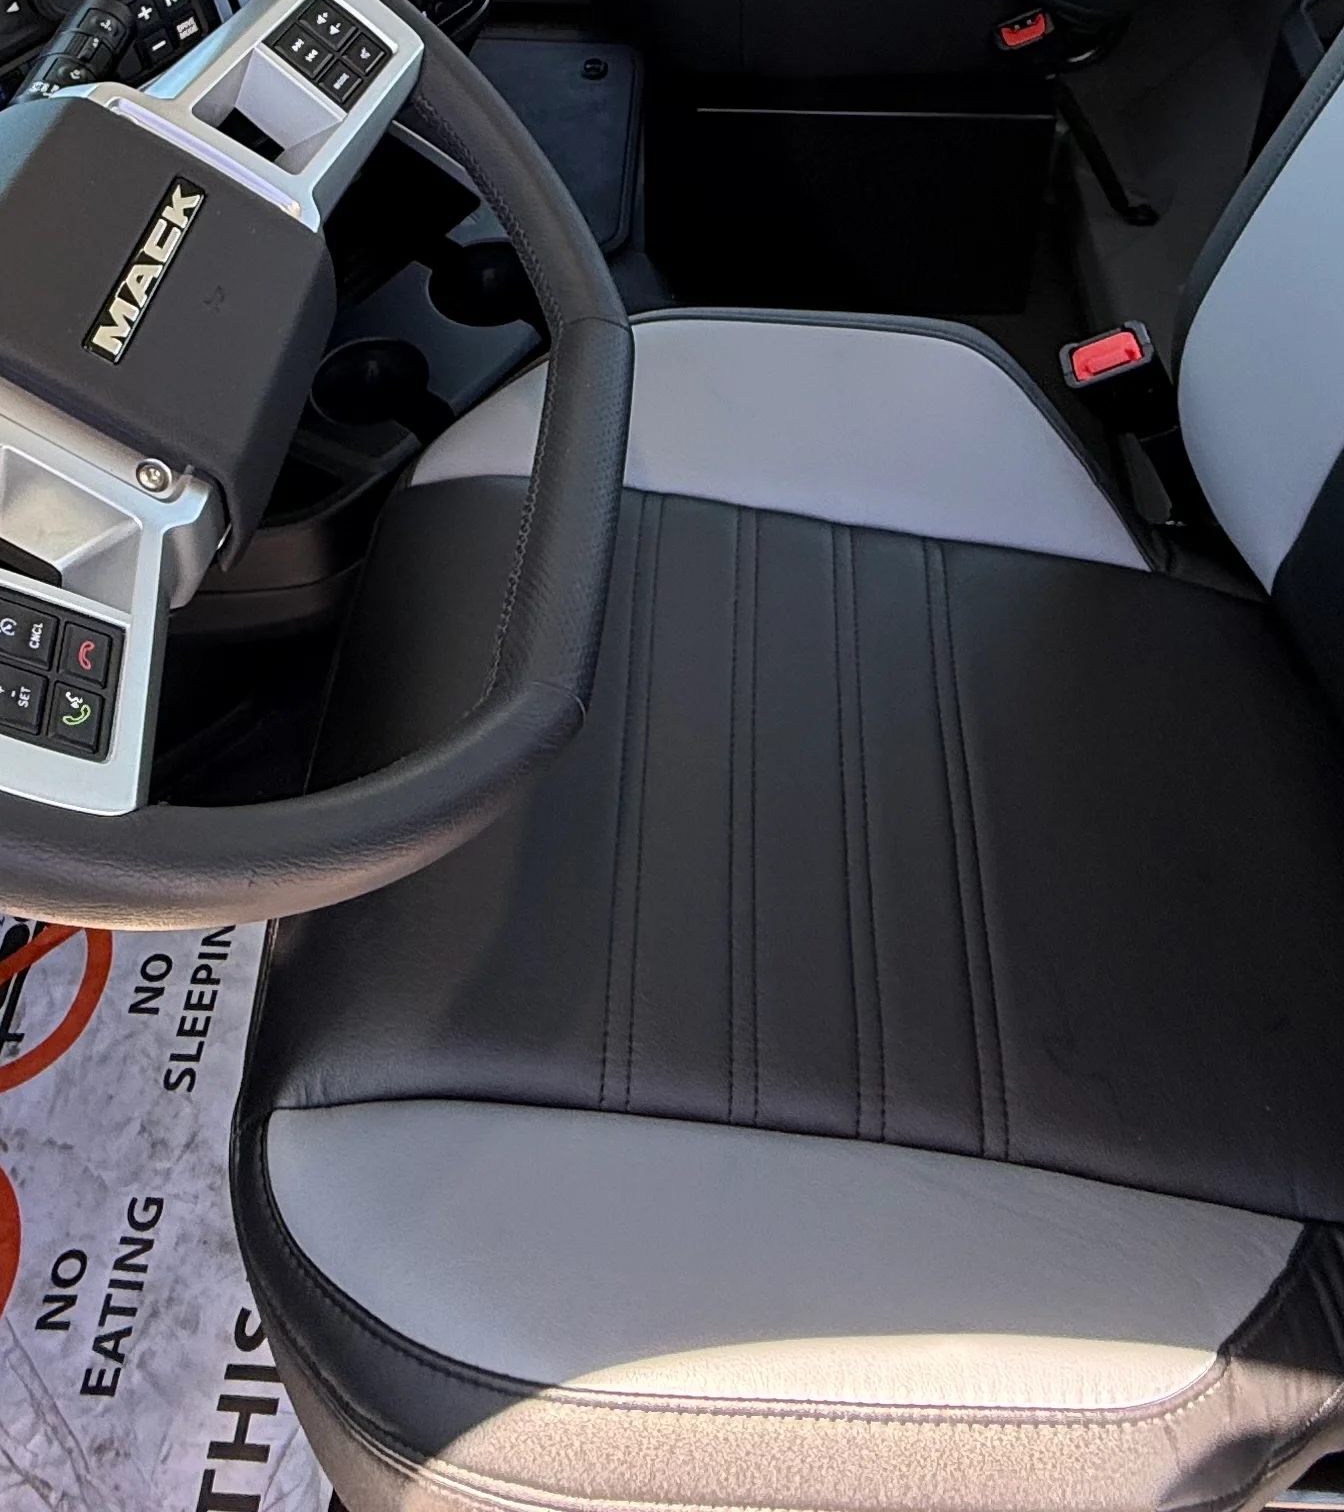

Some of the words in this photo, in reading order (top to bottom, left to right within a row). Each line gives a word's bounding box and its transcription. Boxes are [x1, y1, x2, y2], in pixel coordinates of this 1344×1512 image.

[179, 24, 199, 40] MODE
[92, 185, 201, 356] MACK
[29, 622, 44, 649] CNCL
[17, 686, 31, 708] SET
[128, 953, 174, 1015] NO
[35, 1248, 88, 1331] NO
[80, 1196, 164, 1398] EATING
